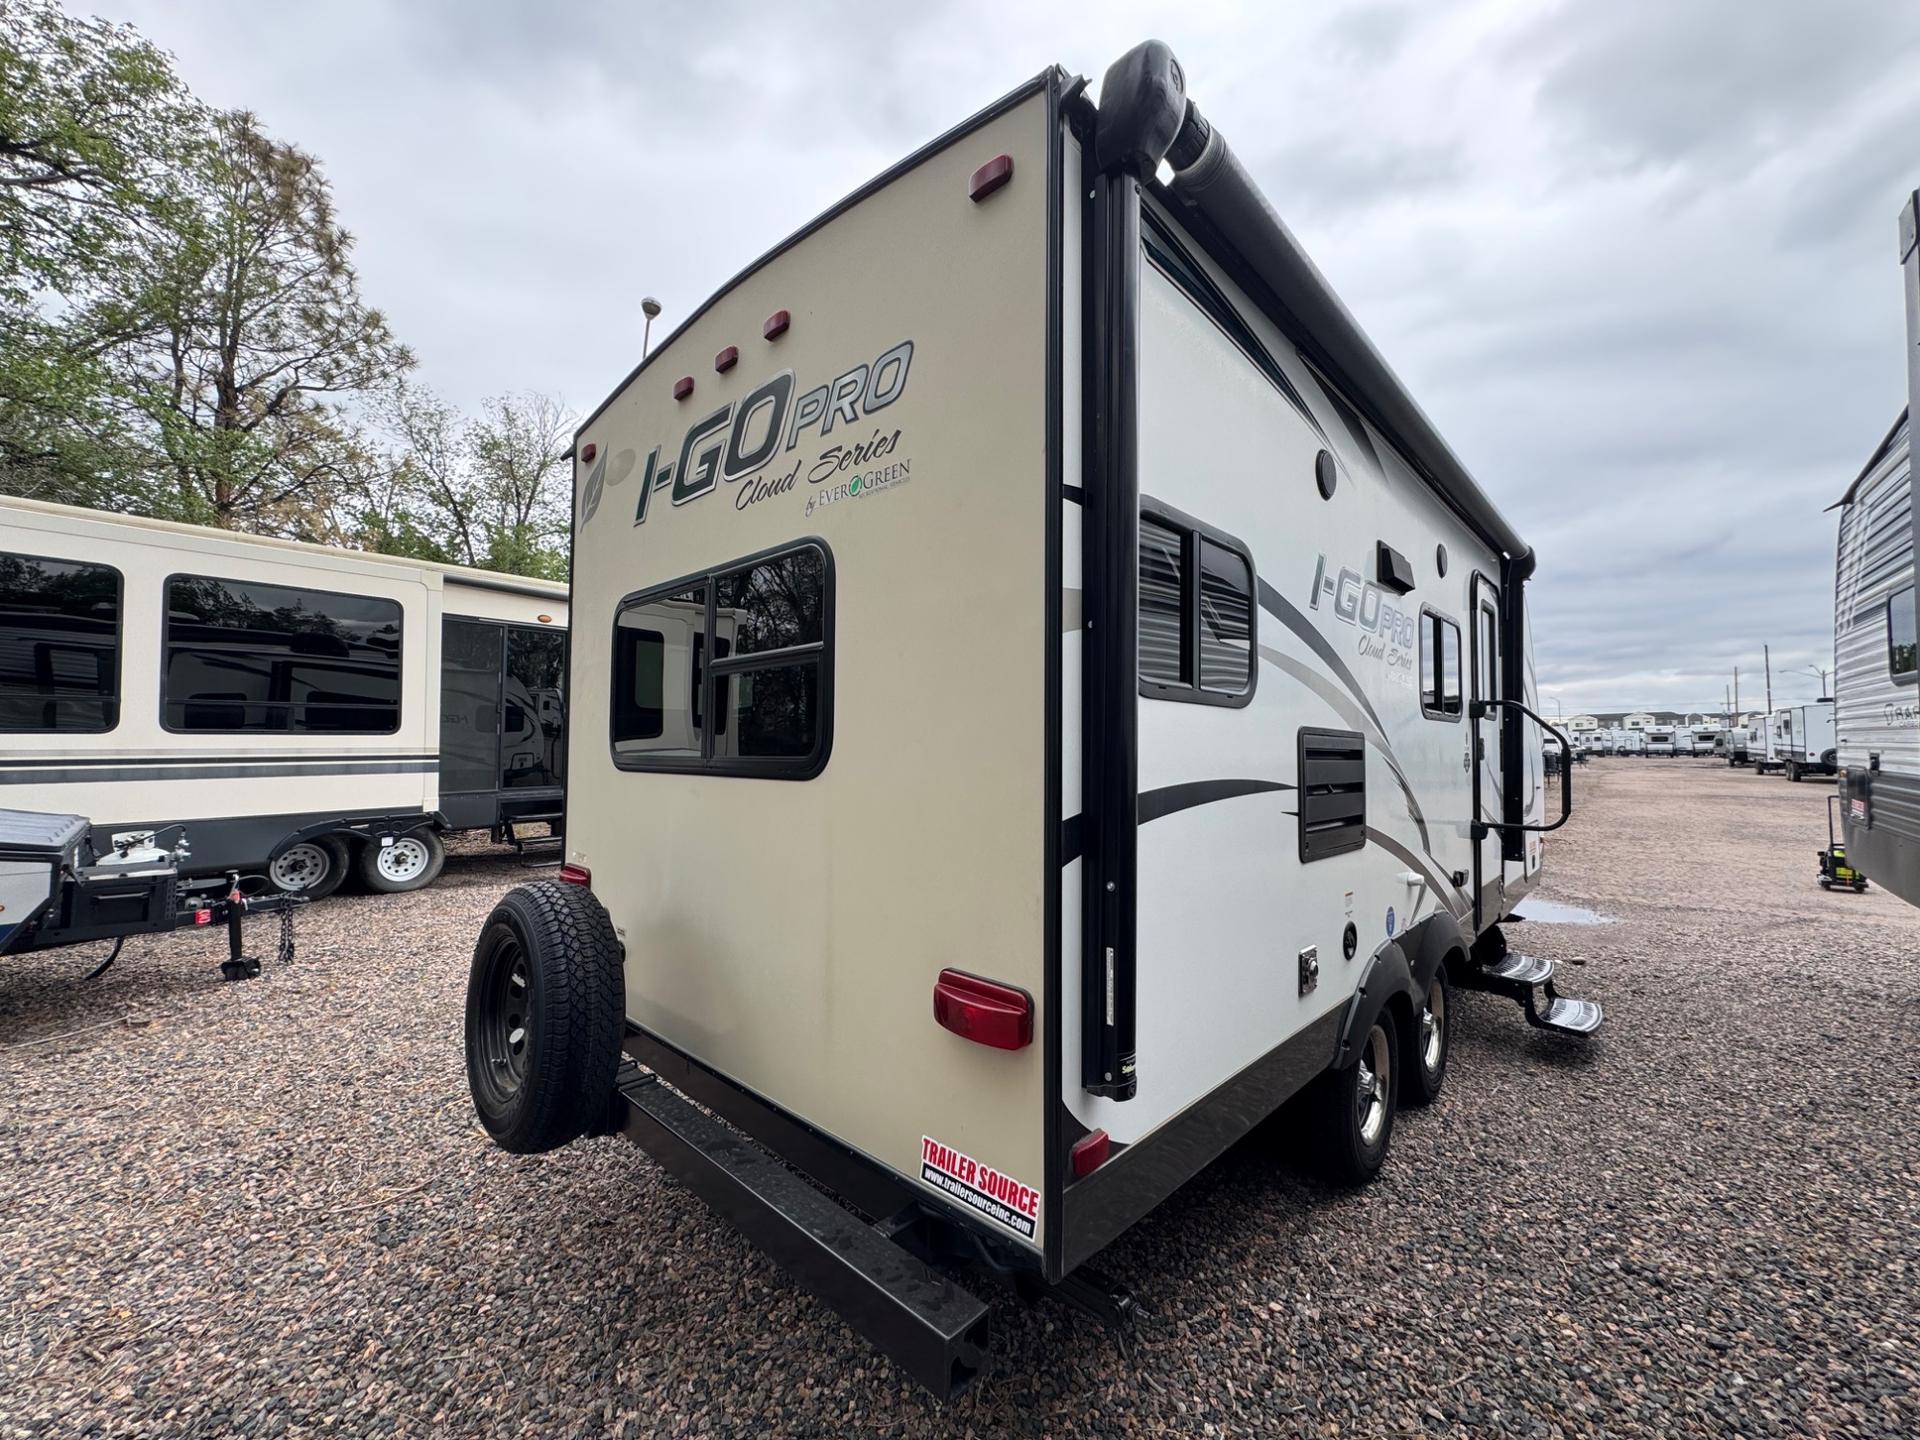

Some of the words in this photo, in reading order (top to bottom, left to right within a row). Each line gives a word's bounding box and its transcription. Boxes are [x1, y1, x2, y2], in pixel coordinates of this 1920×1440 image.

[633, 368, 797, 528] I-GO
[786, 339, 915, 453] PRO
[735, 459, 802, 511] Cloud
[807, 428, 902, 484] Series
[1379, 603, 1415, 649] PRO
[923, 1138, 977, 1186] TRAILER
[978, 1165, 1040, 1218] SOURCE
